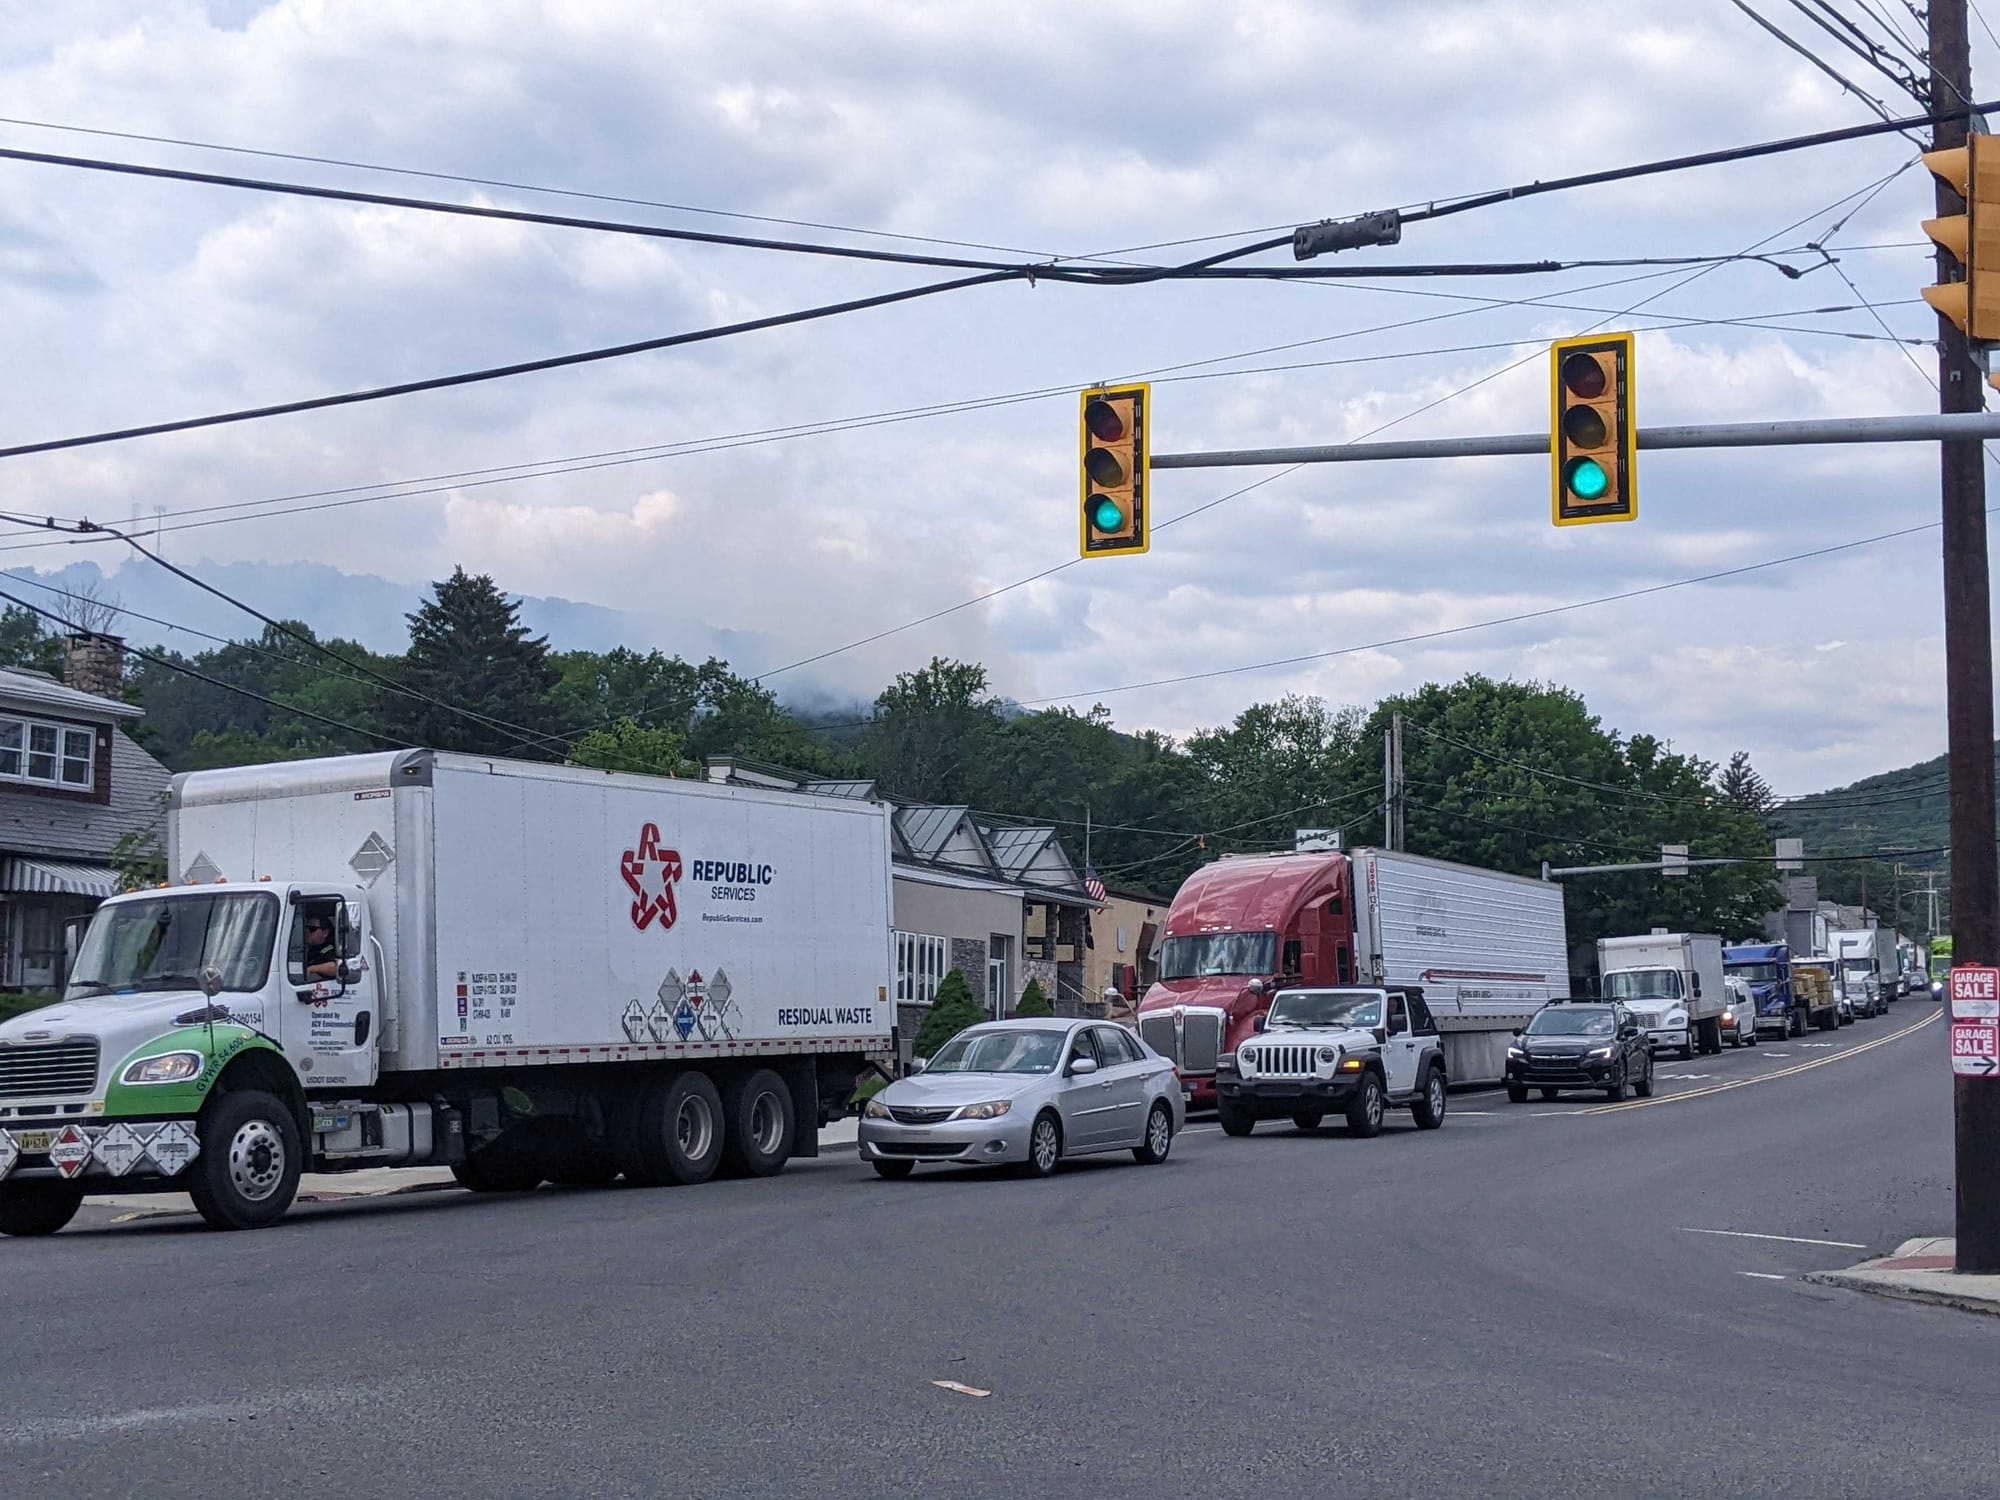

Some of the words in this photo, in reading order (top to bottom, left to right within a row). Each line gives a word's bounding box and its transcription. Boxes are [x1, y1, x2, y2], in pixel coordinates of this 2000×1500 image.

[692, 860, 772, 885] REPUBLIC
[711, 886, 756, 901] SERVICES
[702, 913, 763, 923] RepublicServices.com
[1954, 972, 1994, 983] GARAGE
[1955, 983, 1994, 998] SALE
[778, 1008, 833, 1026] RESIDUAL
[835, 1007, 872, 1024] WASTE
[1955, 1028, 1993, 1039] GARAGE
[1955, 1039, 1993, 1054] SALE
[196, 1060, 221, 1092] GVWR
